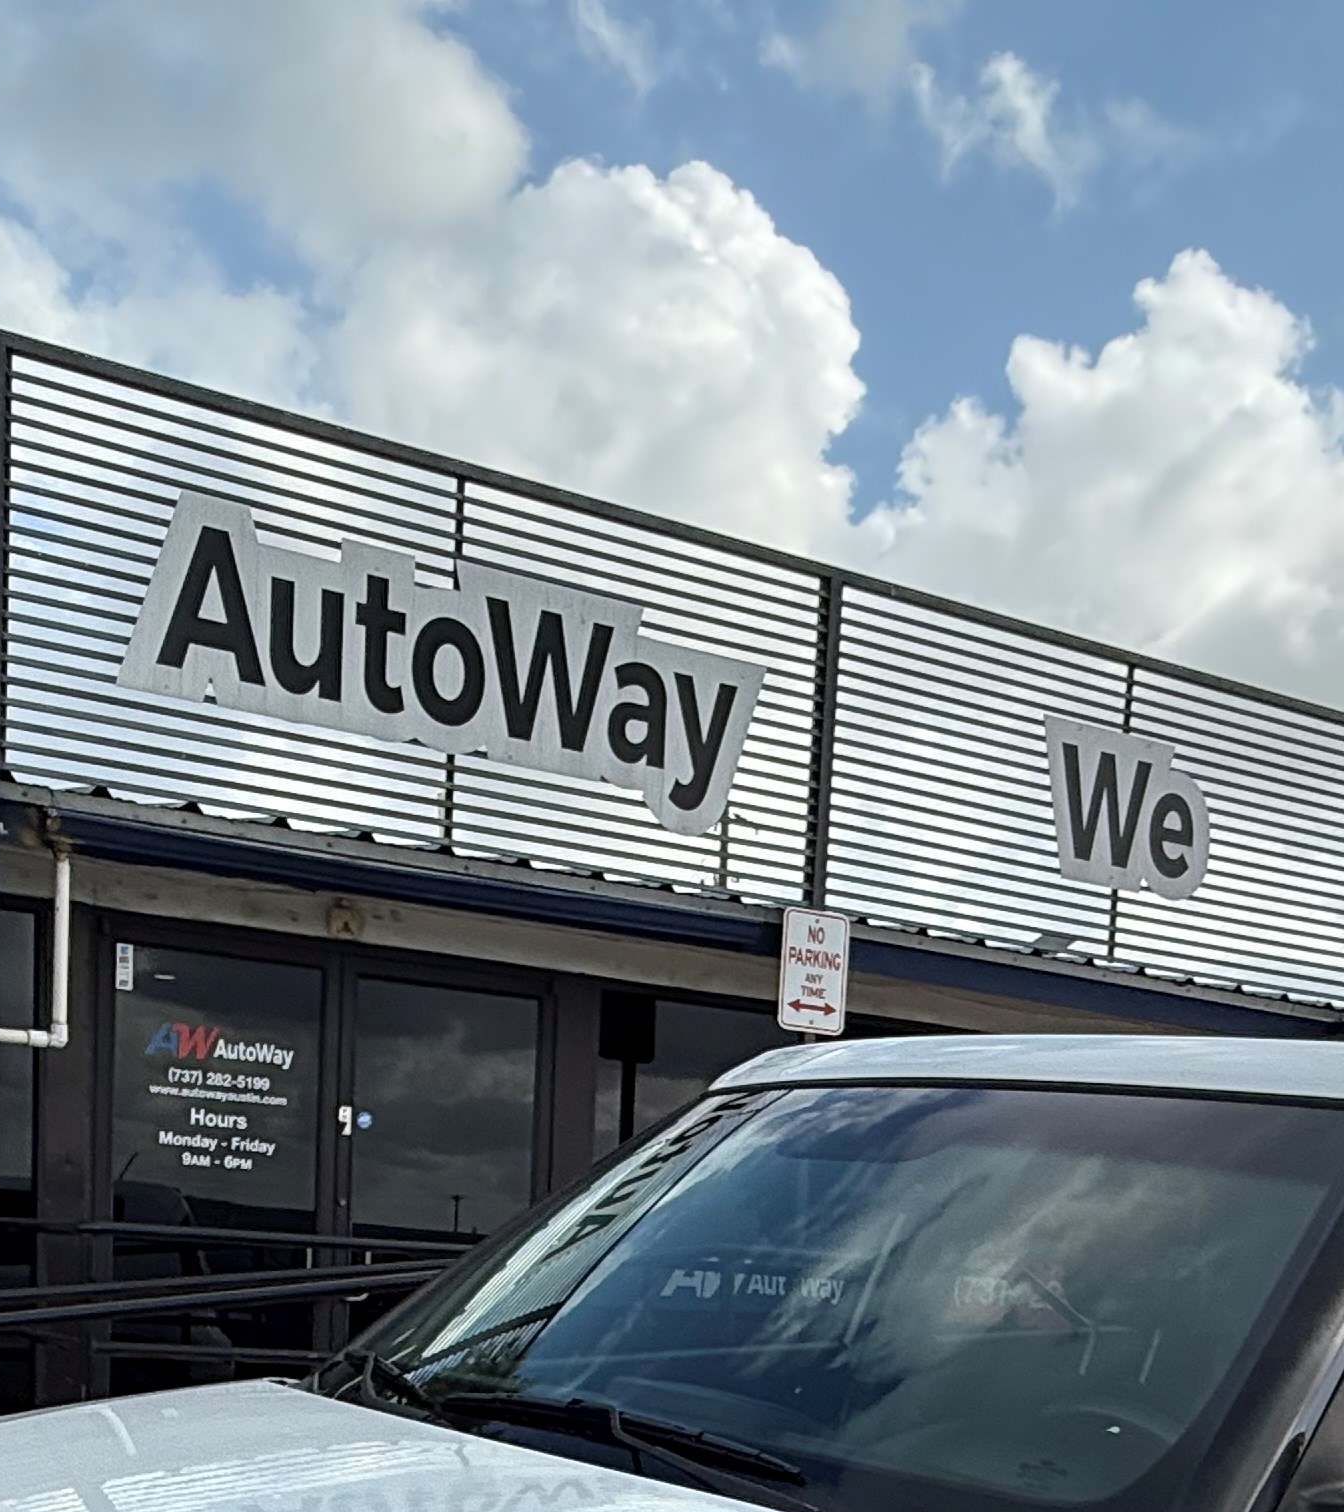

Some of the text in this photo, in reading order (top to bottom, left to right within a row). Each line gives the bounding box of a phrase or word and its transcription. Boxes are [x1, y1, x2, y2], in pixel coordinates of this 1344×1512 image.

[156, 526, 737, 811] AutoWay
[1062, 742, 1194, 879] We
[806, 925, 825, 944] NO
[788, 946, 841, 971] PARKING
[805, 973, 823, 985] ANY
[801, 985, 826, 999] TIME
[145, 1022, 295, 1070] AW AutoWay
[168, 1067, 270, 1091] (737) 282-5199
[149, 1084, 288, 1106] www.autowayaustin.com
[190, 1108, 248, 1130] Hours
[158, 1131, 217, 1152] Monday
[231, 1137, 276, 1156] Friday
[181, 1152, 211, 1167] 9AM
[224, 1155, 252, 1170] 6PM
